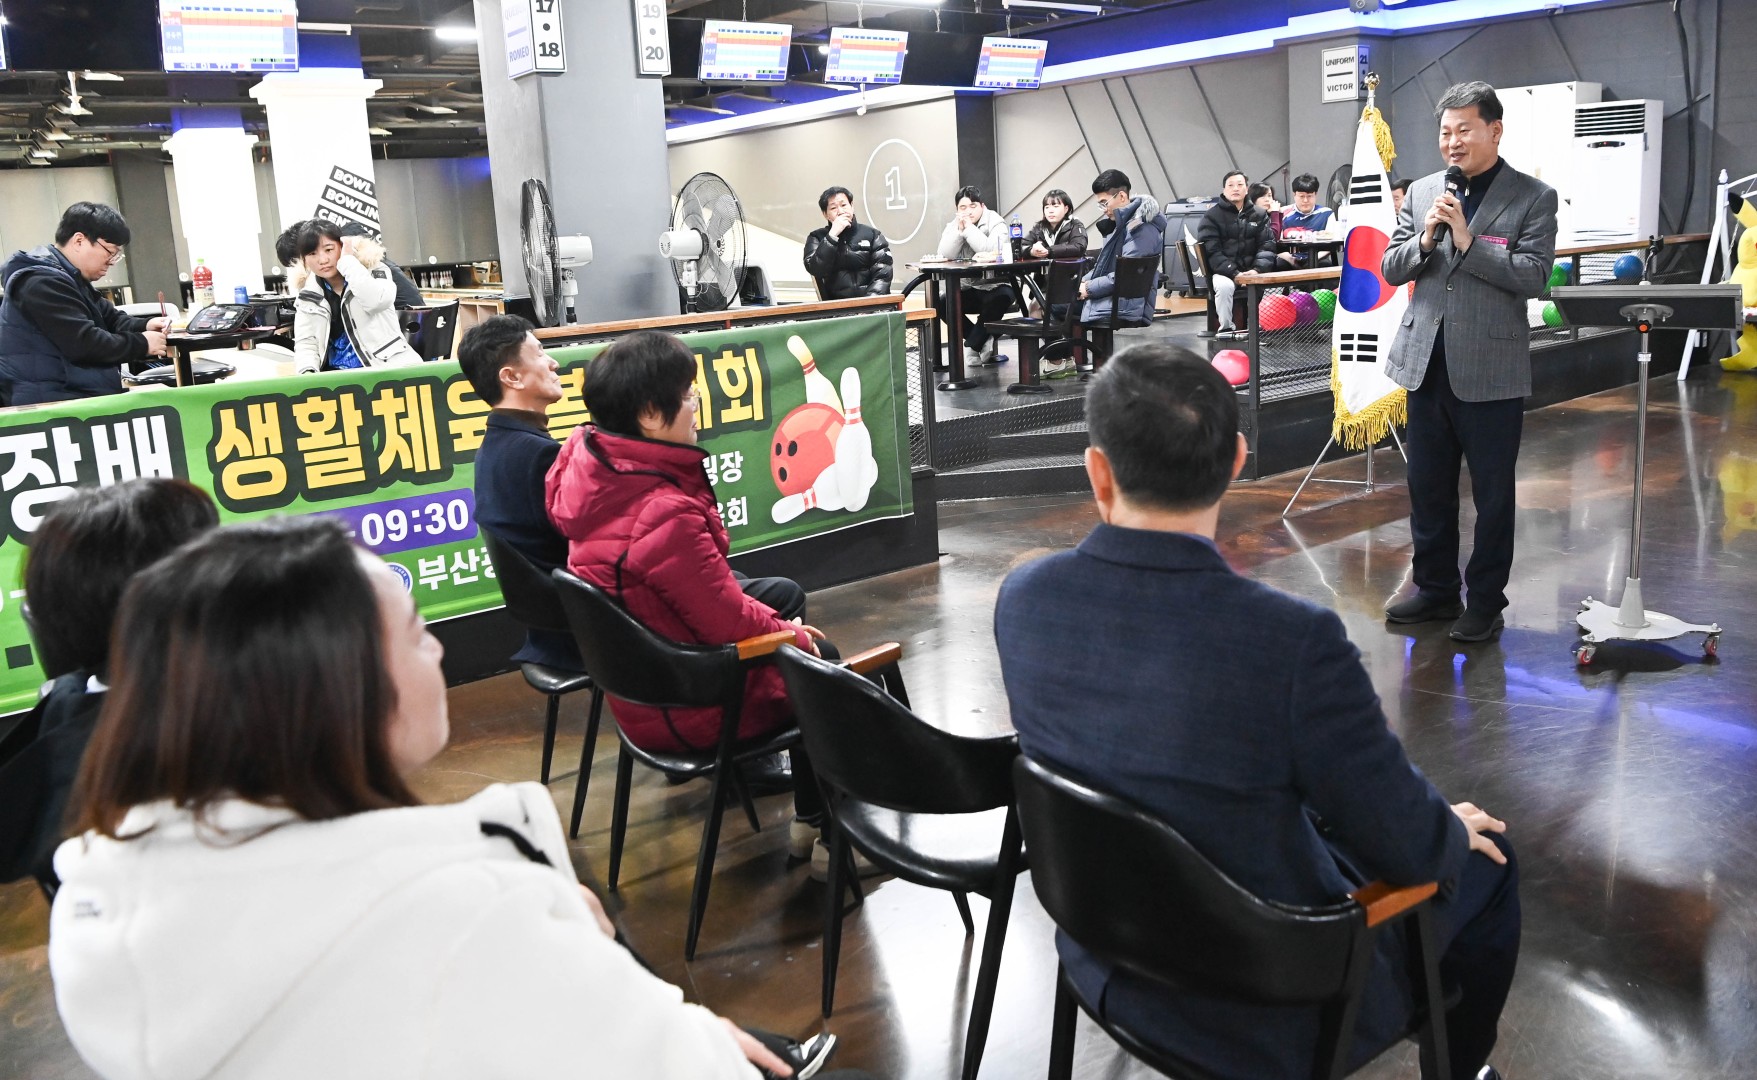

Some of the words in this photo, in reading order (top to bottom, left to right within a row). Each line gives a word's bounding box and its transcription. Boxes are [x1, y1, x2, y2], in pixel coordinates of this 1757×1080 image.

[535, 0, 554, 13] 17
[642, 4, 660, 18] 19
[508, 45, 530, 62] ROMEO
[538, 42, 560, 57] 18
[645, 46, 664, 60] 20
[1325, 56, 1355, 67] UNIFORM
[1360, 54, 1368, 64] 21
[1326, 83, 1354, 92] VICTOR
[333, 168, 373, 196] BOWL
[885, 166, 907, 210] 1
